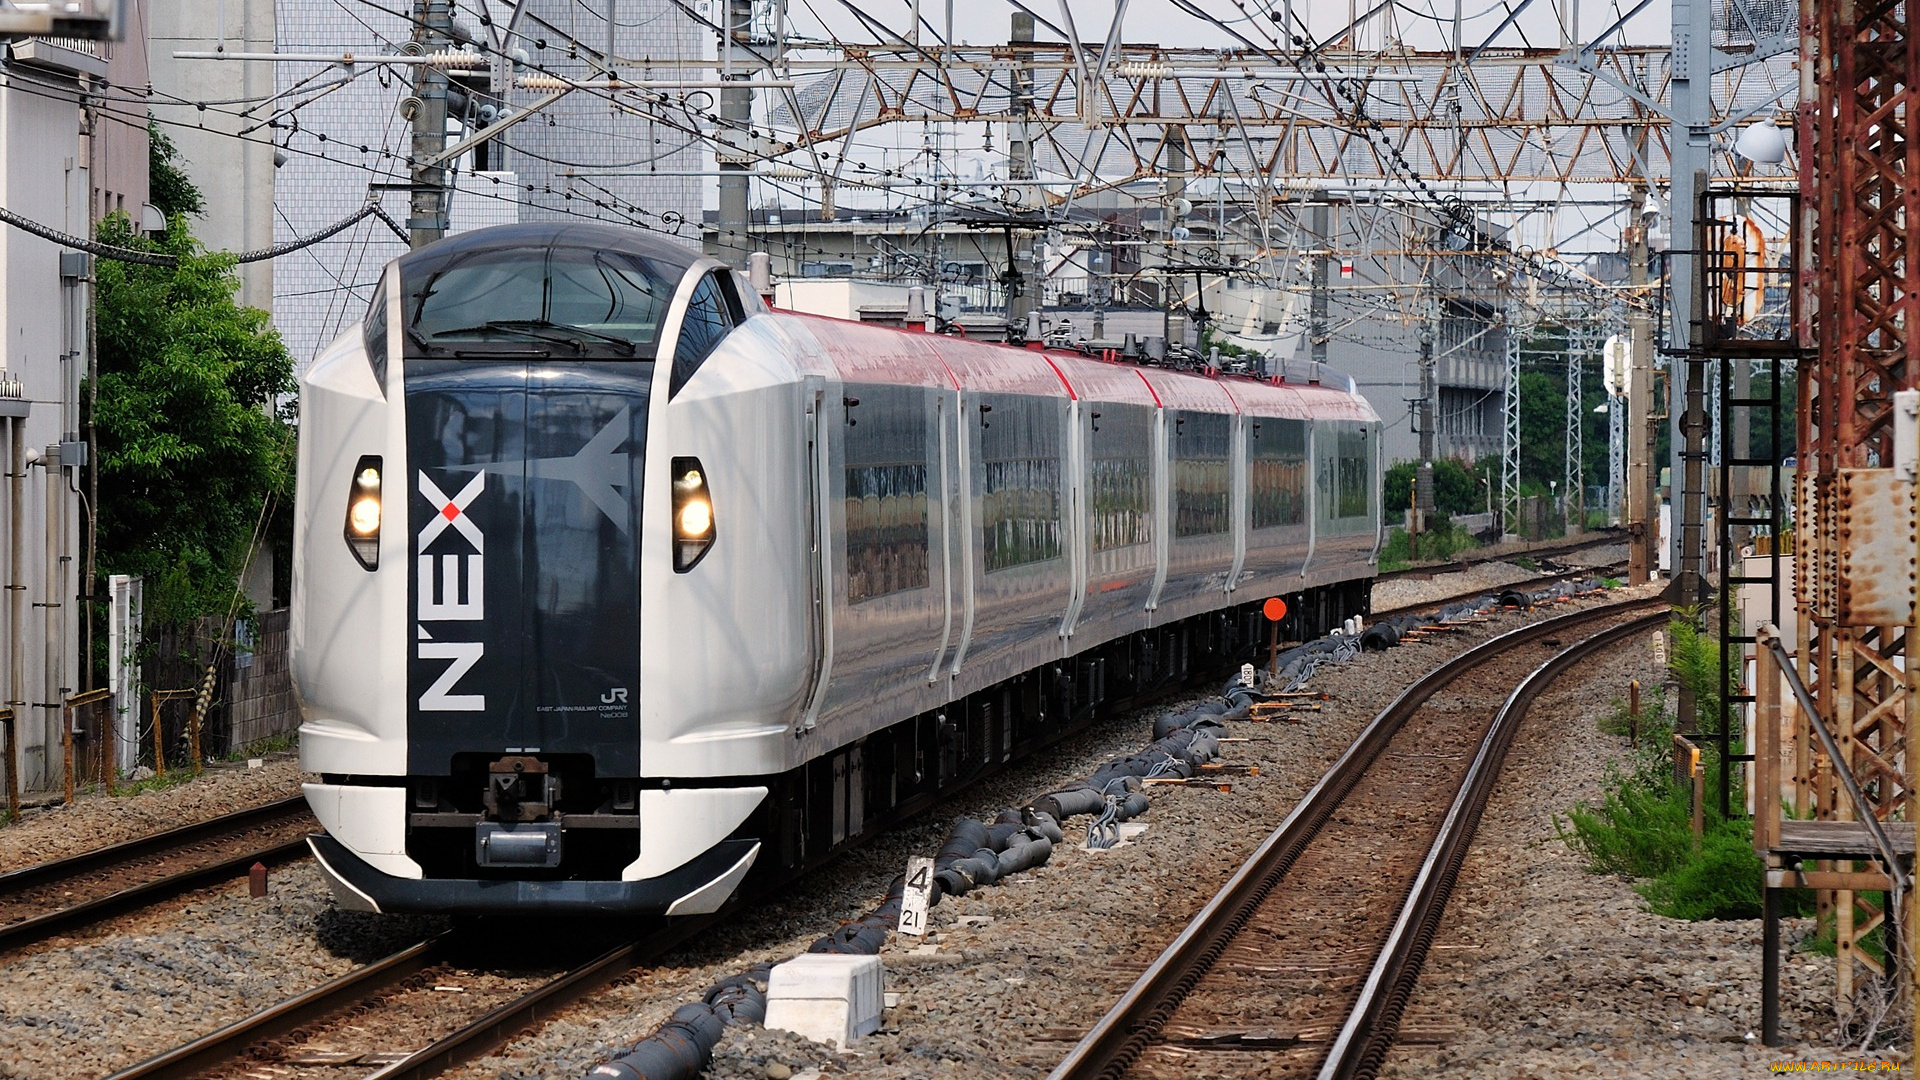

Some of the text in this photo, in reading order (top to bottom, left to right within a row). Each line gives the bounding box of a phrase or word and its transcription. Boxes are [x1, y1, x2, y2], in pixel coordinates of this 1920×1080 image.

[601, 687, 628, 704] JR
[598, 704, 628, 712] COMPANY
[907, 866, 928, 893] 4
